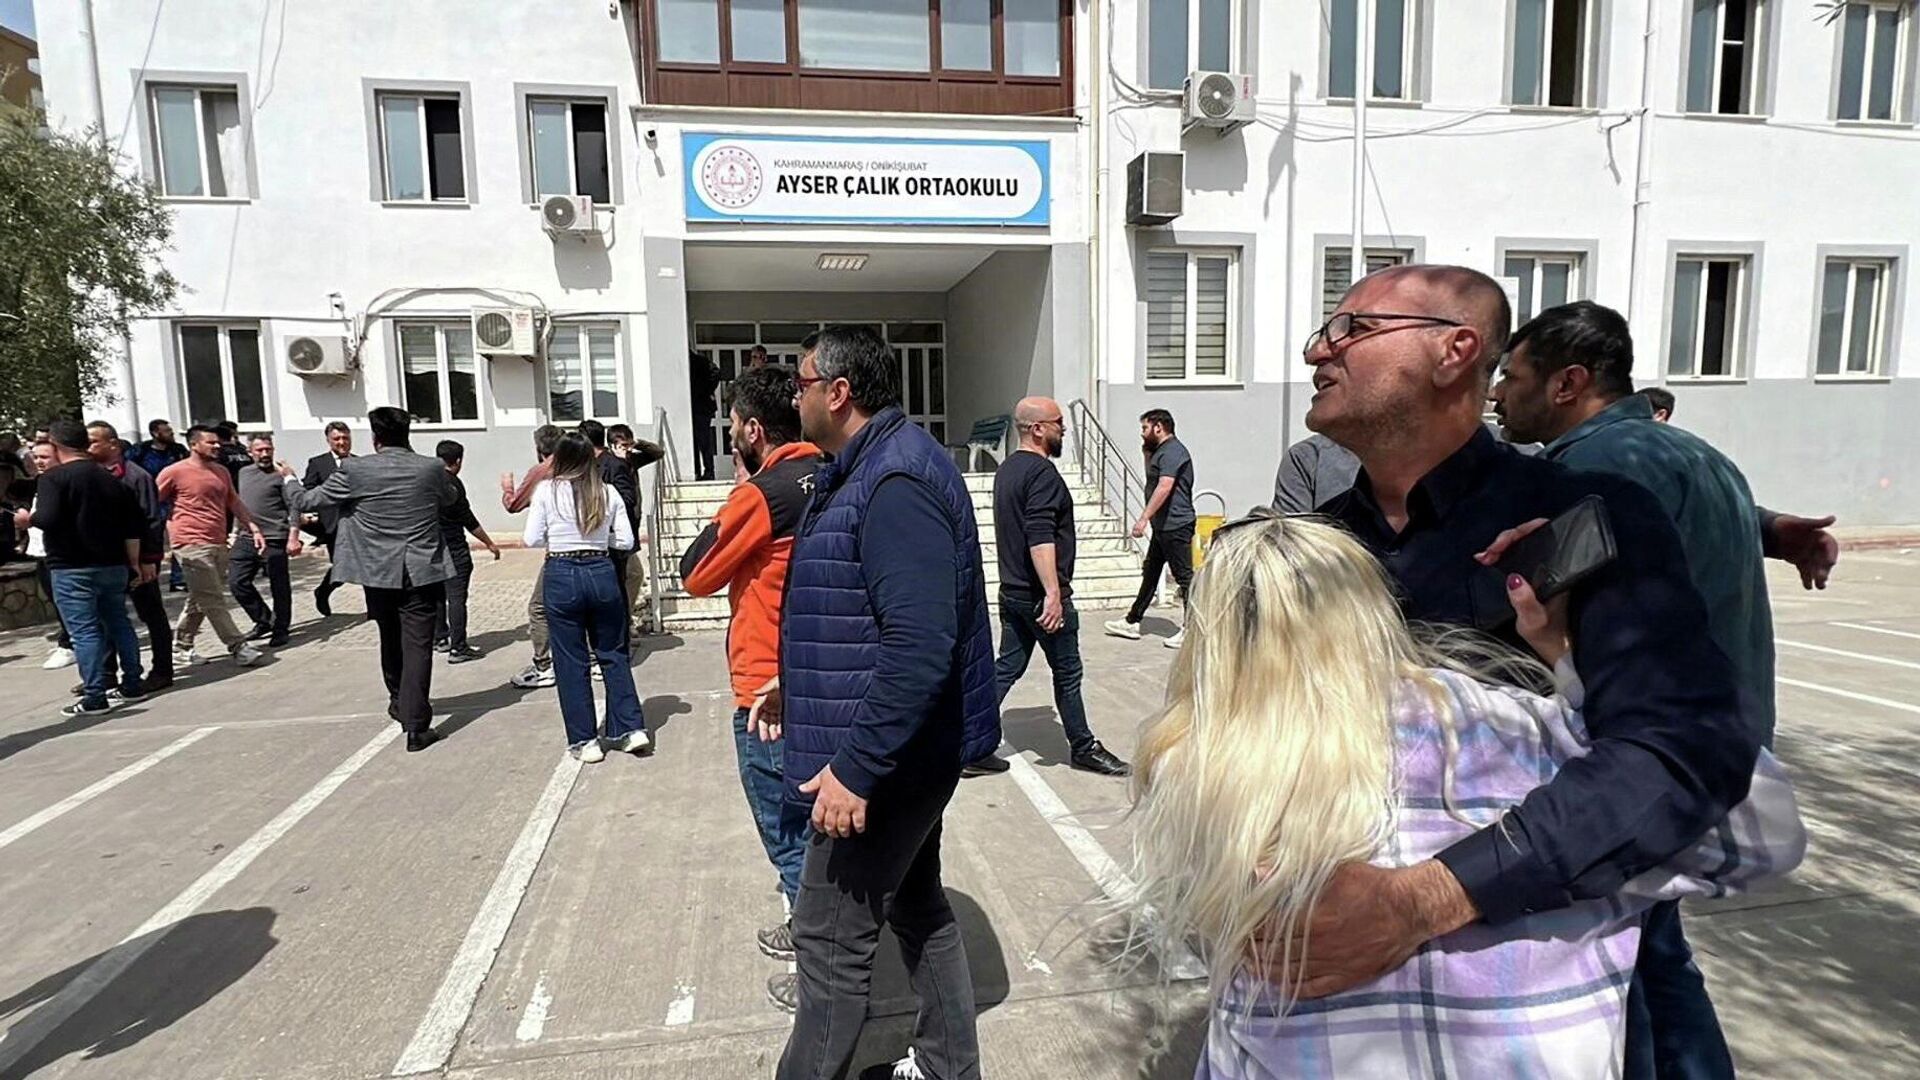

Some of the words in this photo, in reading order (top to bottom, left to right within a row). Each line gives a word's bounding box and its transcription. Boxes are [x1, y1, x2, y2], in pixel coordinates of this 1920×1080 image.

[774, 159, 863, 172] KAHRAMANMARAŞ
[865, 160, 870, 171] /
[871, 160, 928, 172] ONİKİŞUBAT
[776, 174, 838, 194] AYSER
[843, 176, 900, 198] ÇALIK
[905, 176, 1018, 197] ORTAOKULU
